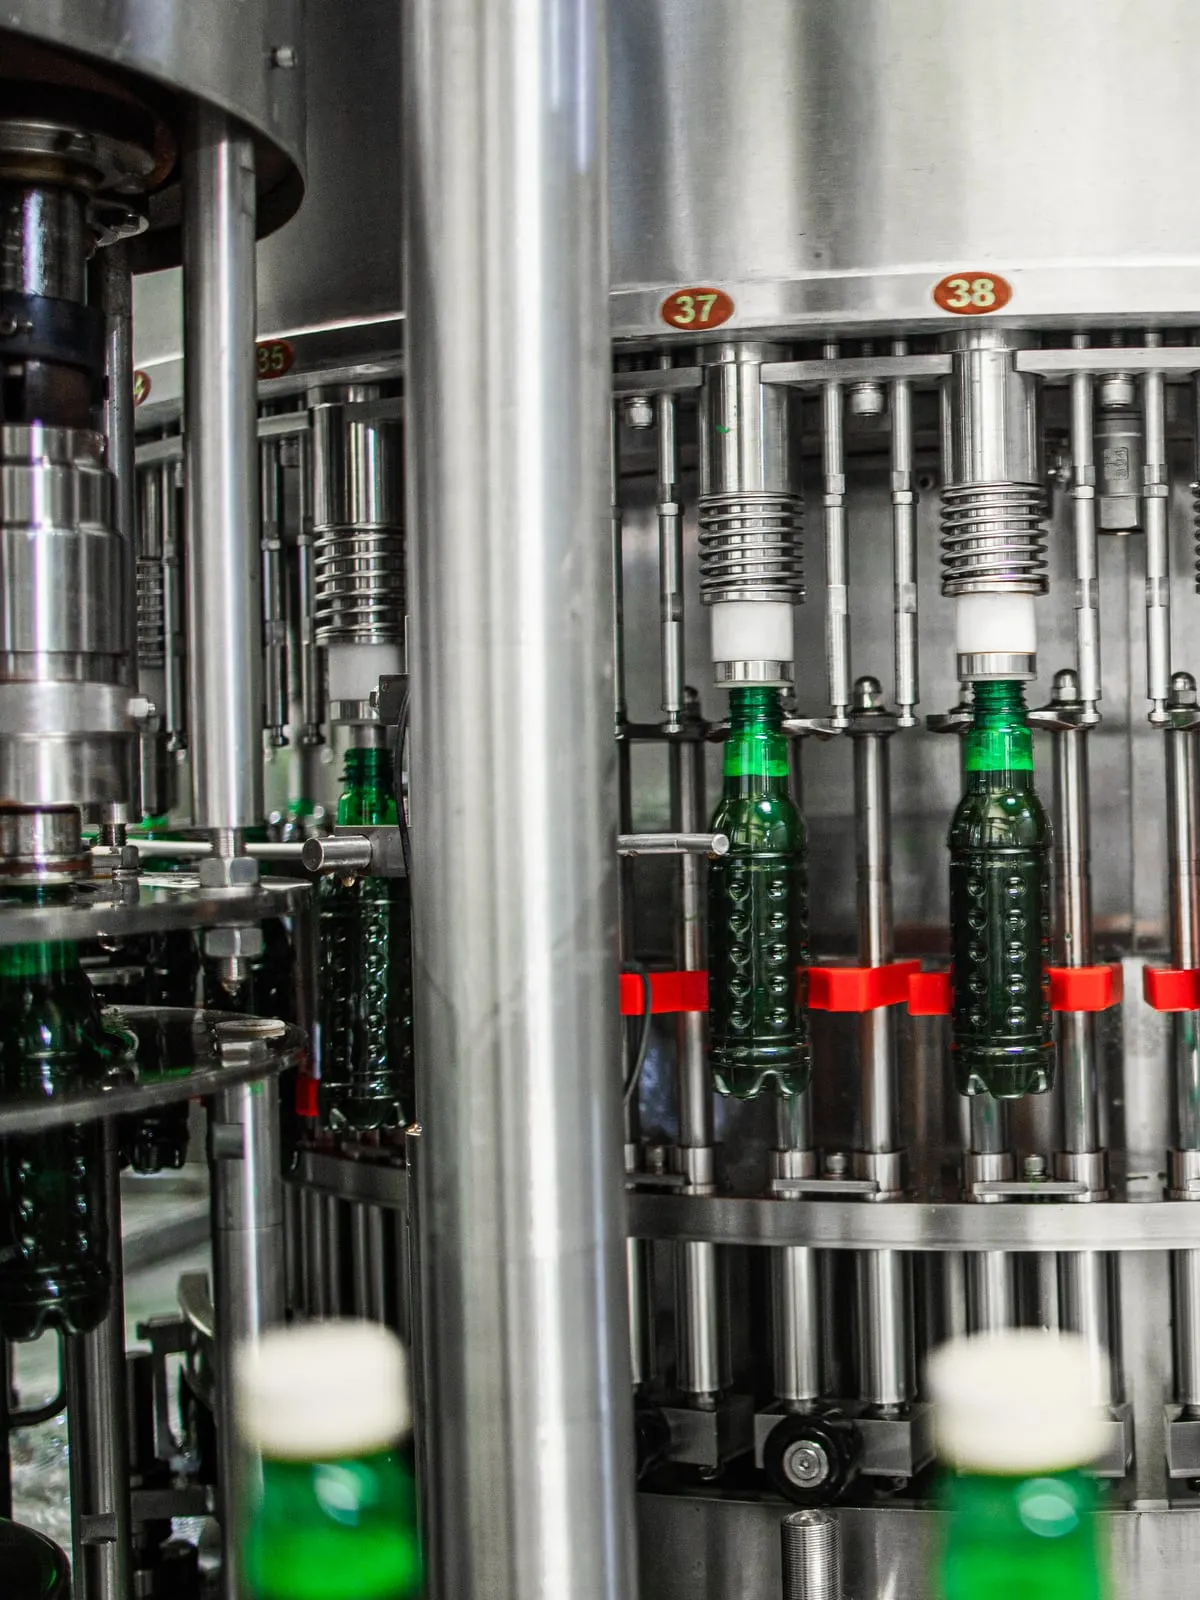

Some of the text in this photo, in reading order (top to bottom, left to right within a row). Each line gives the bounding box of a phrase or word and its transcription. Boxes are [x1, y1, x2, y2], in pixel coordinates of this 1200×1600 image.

[946, 278, 996, 308] 38
[674, 294, 718, 324] 37
[259, 345, 284, 373] 35
